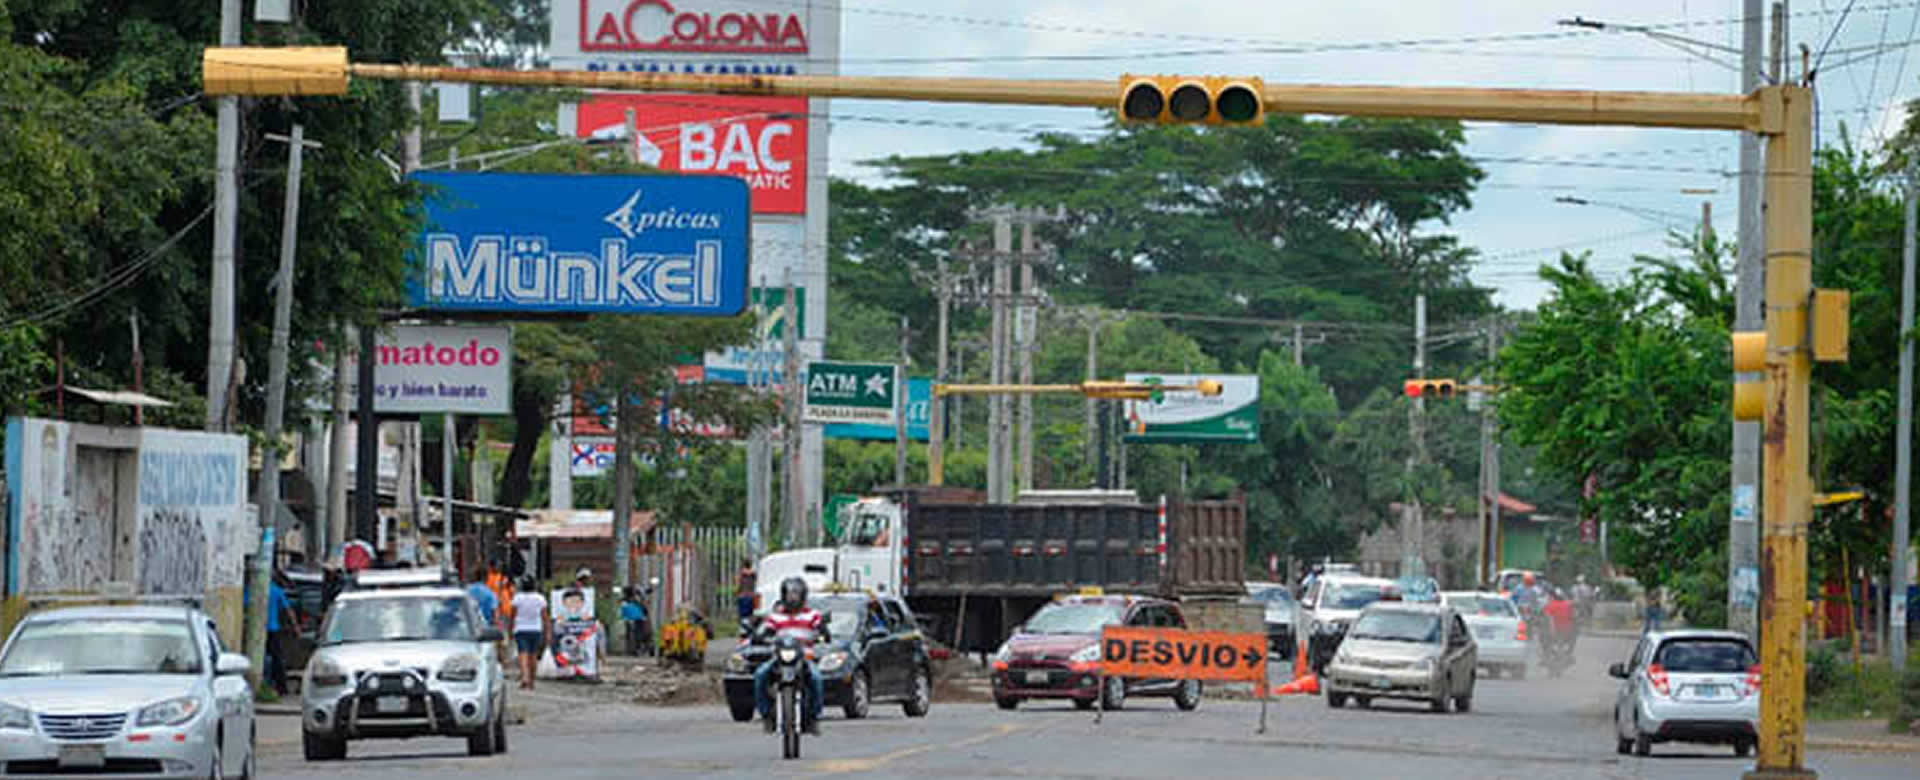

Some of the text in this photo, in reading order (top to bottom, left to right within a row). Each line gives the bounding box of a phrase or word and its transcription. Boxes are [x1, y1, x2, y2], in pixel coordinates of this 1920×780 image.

[680, 122, 792, 172] BAC
[427, 234, 722, 307] Münkel
[809, 373, 857, 393] ATM
[1105, 639, 1238, 669] DESVIO
